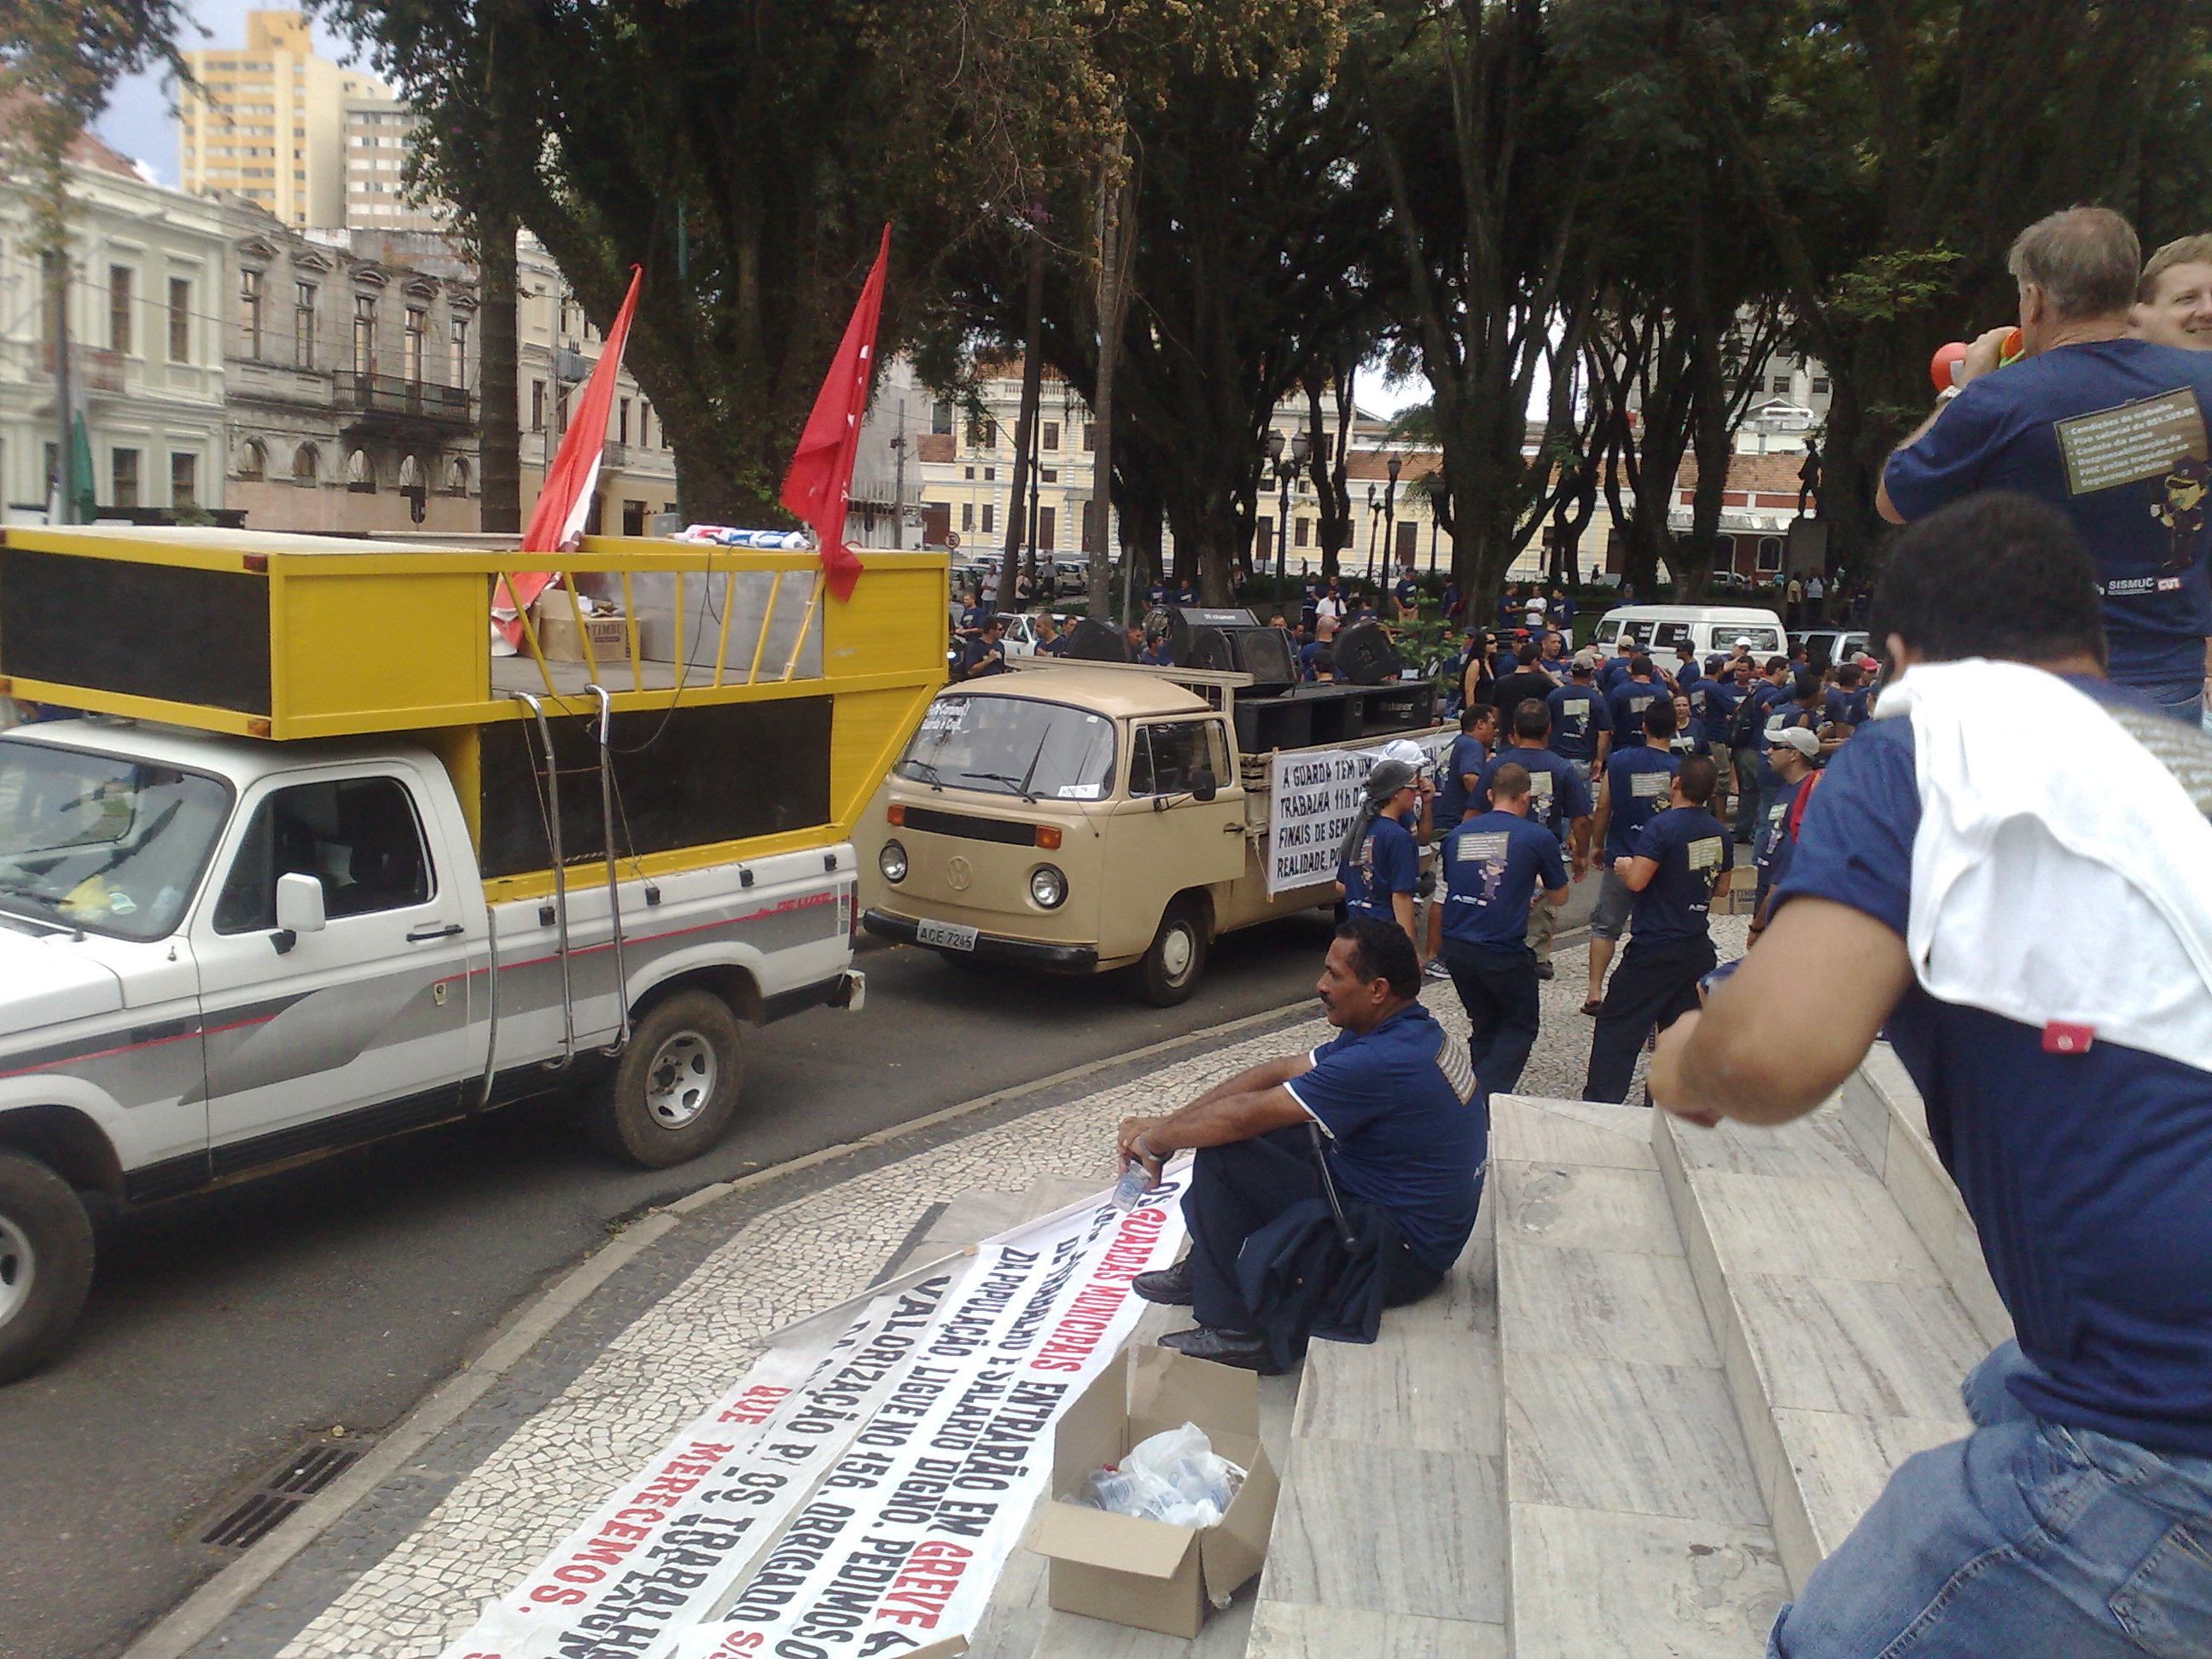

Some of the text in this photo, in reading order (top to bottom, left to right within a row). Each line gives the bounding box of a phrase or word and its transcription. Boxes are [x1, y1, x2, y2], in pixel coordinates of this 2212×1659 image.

[2108, 577, 2180, 591] SISMUC CUT
[1283, 766, 1290, 789] A
[1293, 762, 1332, 787] GUARDA
[1335, 758, 1355, 781] TEM
[1280, 791, 1330, 818] TRABALHA
[1335, 787, 1351, 809] 11h
[1279, 824, 1312, 848] FINAIS
[1314, 822, 1326, 842] DE
[1277, 850, 1328, 879] REALIDADE,
[921, 928, 945, 943] ACE
[1138, 1181, 1181, 1208] OS
[992, 1247, 1040, 1271] DA
[1091, 1208, 1167, 1282] GUARDAS
[917, 1272, 1029, 1362] POPULAÇÃO,
[1029, 1283, 1132, 1372] MUNICIPAIS
[785, 1275, 952, 1435] VALORIZAÇÃO
[879, 1365, 959, 1417] LIGUE
[856, 1418, 919, 1447] NO
[952, 1380, 1068, 1490] ENTRARÃO
[721, 1471, 789, 1505] OS
[816, 1452, 896, 1496] 156.
[871, 1457, 963, 1528] DIGNO.
[518, 1385, 794, 1614] QUE MERECEMOS.
[926, 1499, 998, 1537] EM
[723, 1502, 856, 1623] OBRIGADO
[876, 1540, 974, 1629] GREVE
[791, 1535, 917, 1643] PEDIMOS
